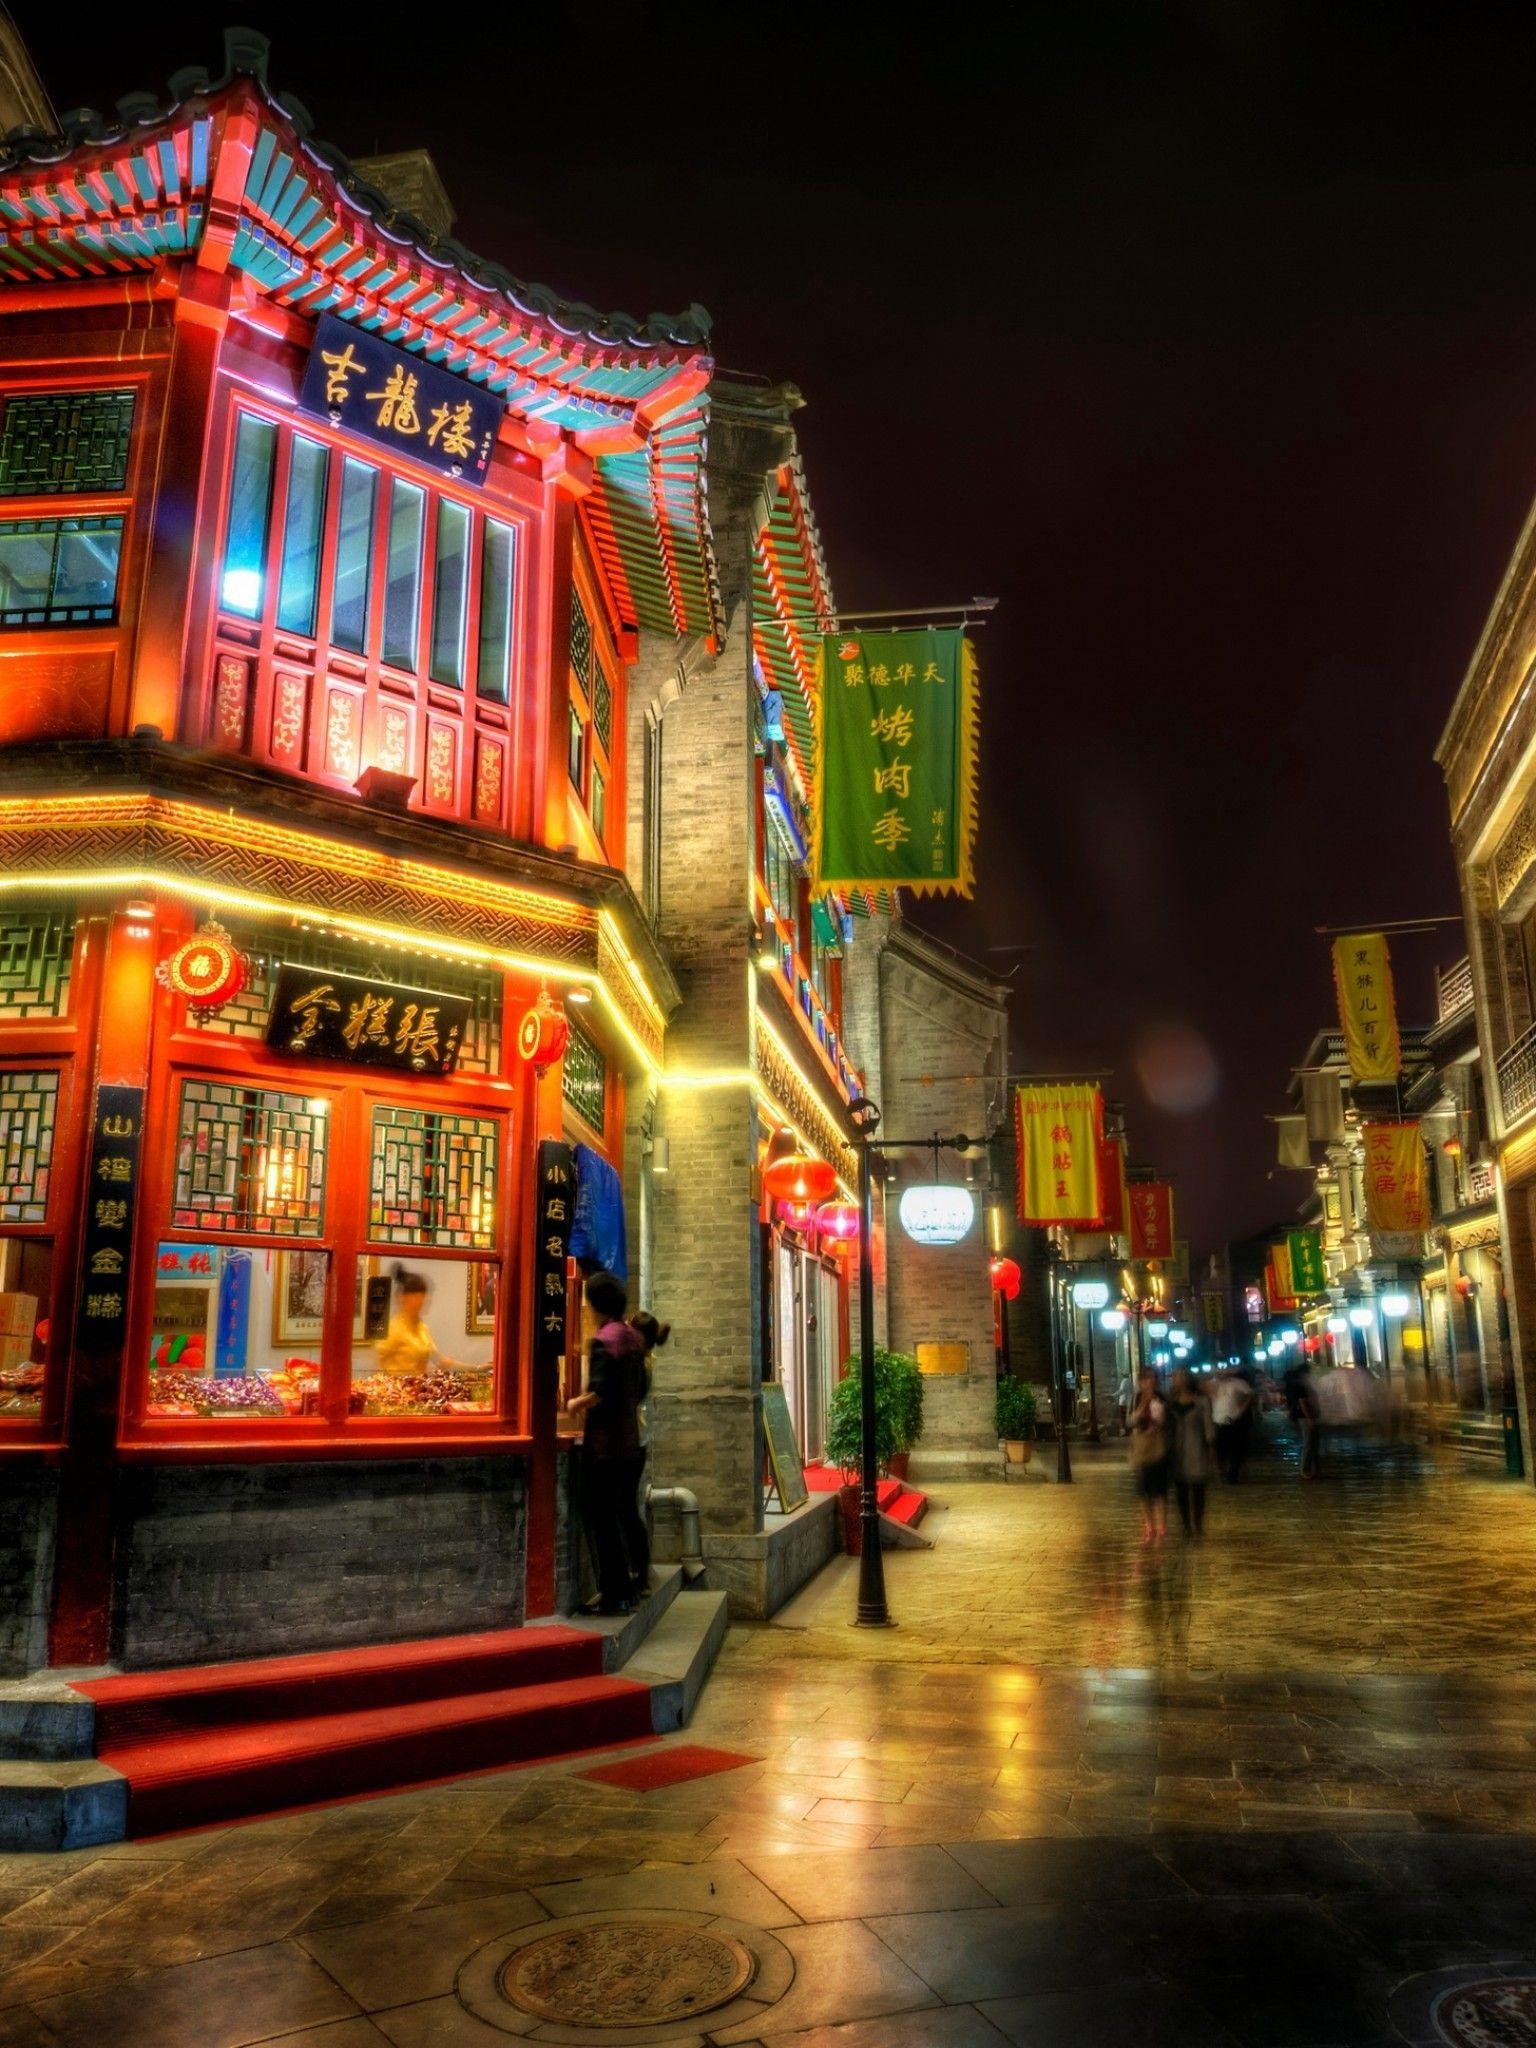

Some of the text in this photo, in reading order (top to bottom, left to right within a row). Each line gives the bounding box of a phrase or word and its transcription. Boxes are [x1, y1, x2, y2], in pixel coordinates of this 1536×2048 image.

[844, 662, 946, 687] 聚德华天
[871, 704, 914, 851] 烤肉季
[1371, 1134, 1397, 1193] 天兴居
